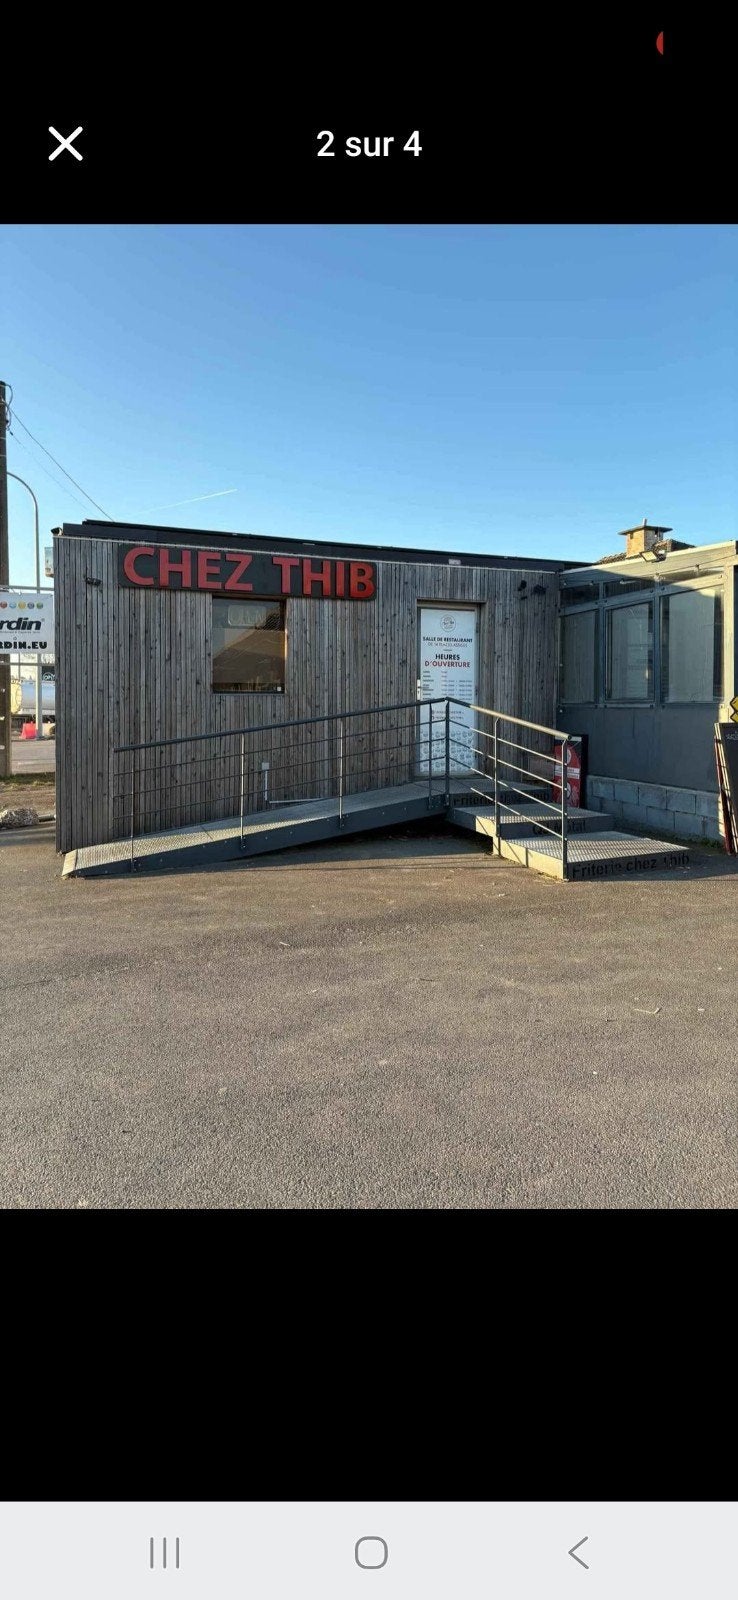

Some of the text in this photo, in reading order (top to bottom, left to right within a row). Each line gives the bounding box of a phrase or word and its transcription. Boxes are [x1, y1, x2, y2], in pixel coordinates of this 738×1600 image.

[123, 546, 376, 599] CHEZ THIB
[424, 660, 471, 668] D'OUVERTURE
[435, 653, 460, 661] HEURES
[572, 861, 622, 879] Friterie
[626, 858, 658, 872] chez
